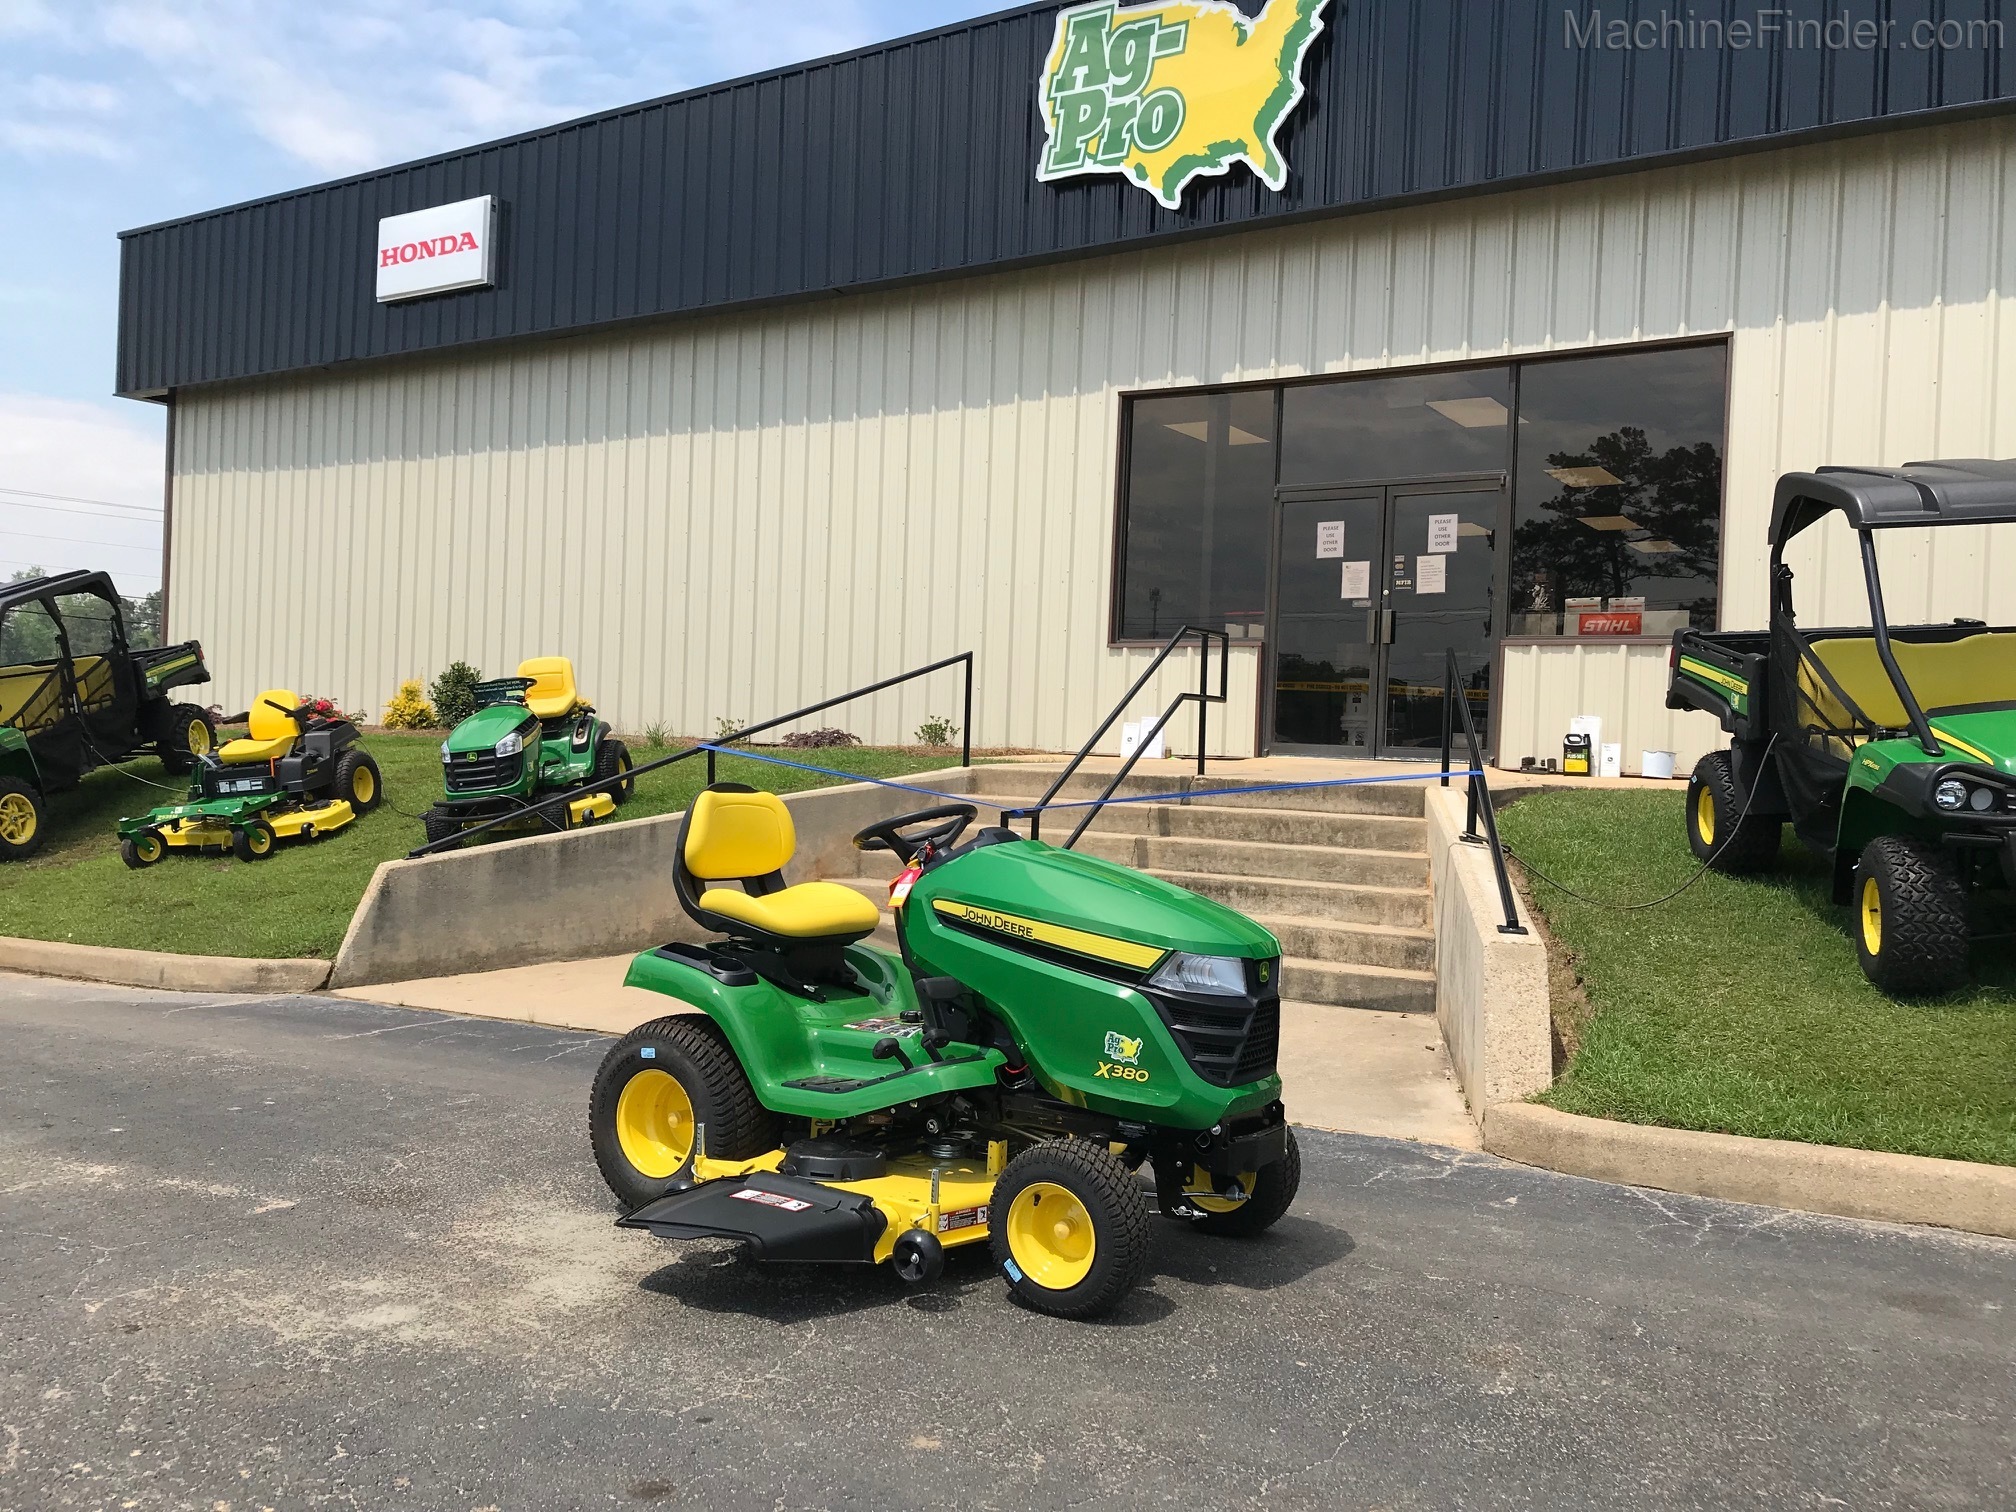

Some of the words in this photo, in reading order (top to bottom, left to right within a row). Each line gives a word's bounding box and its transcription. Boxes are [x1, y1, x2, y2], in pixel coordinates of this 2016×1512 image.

[1050, 5, 1187, 100] Ag-
[1048, 88, 1184, 170] Pro
[380, 231, 479, 268] HONDA
[1582, 619, 1635, 632] STIHL
[962, 907, 992, 926] JOHN
[994, 915, 1034, 938] DEERE
[1106, 1042, 1124, 1054] Pro
[1093, 1061, 1150, 1082] X380
